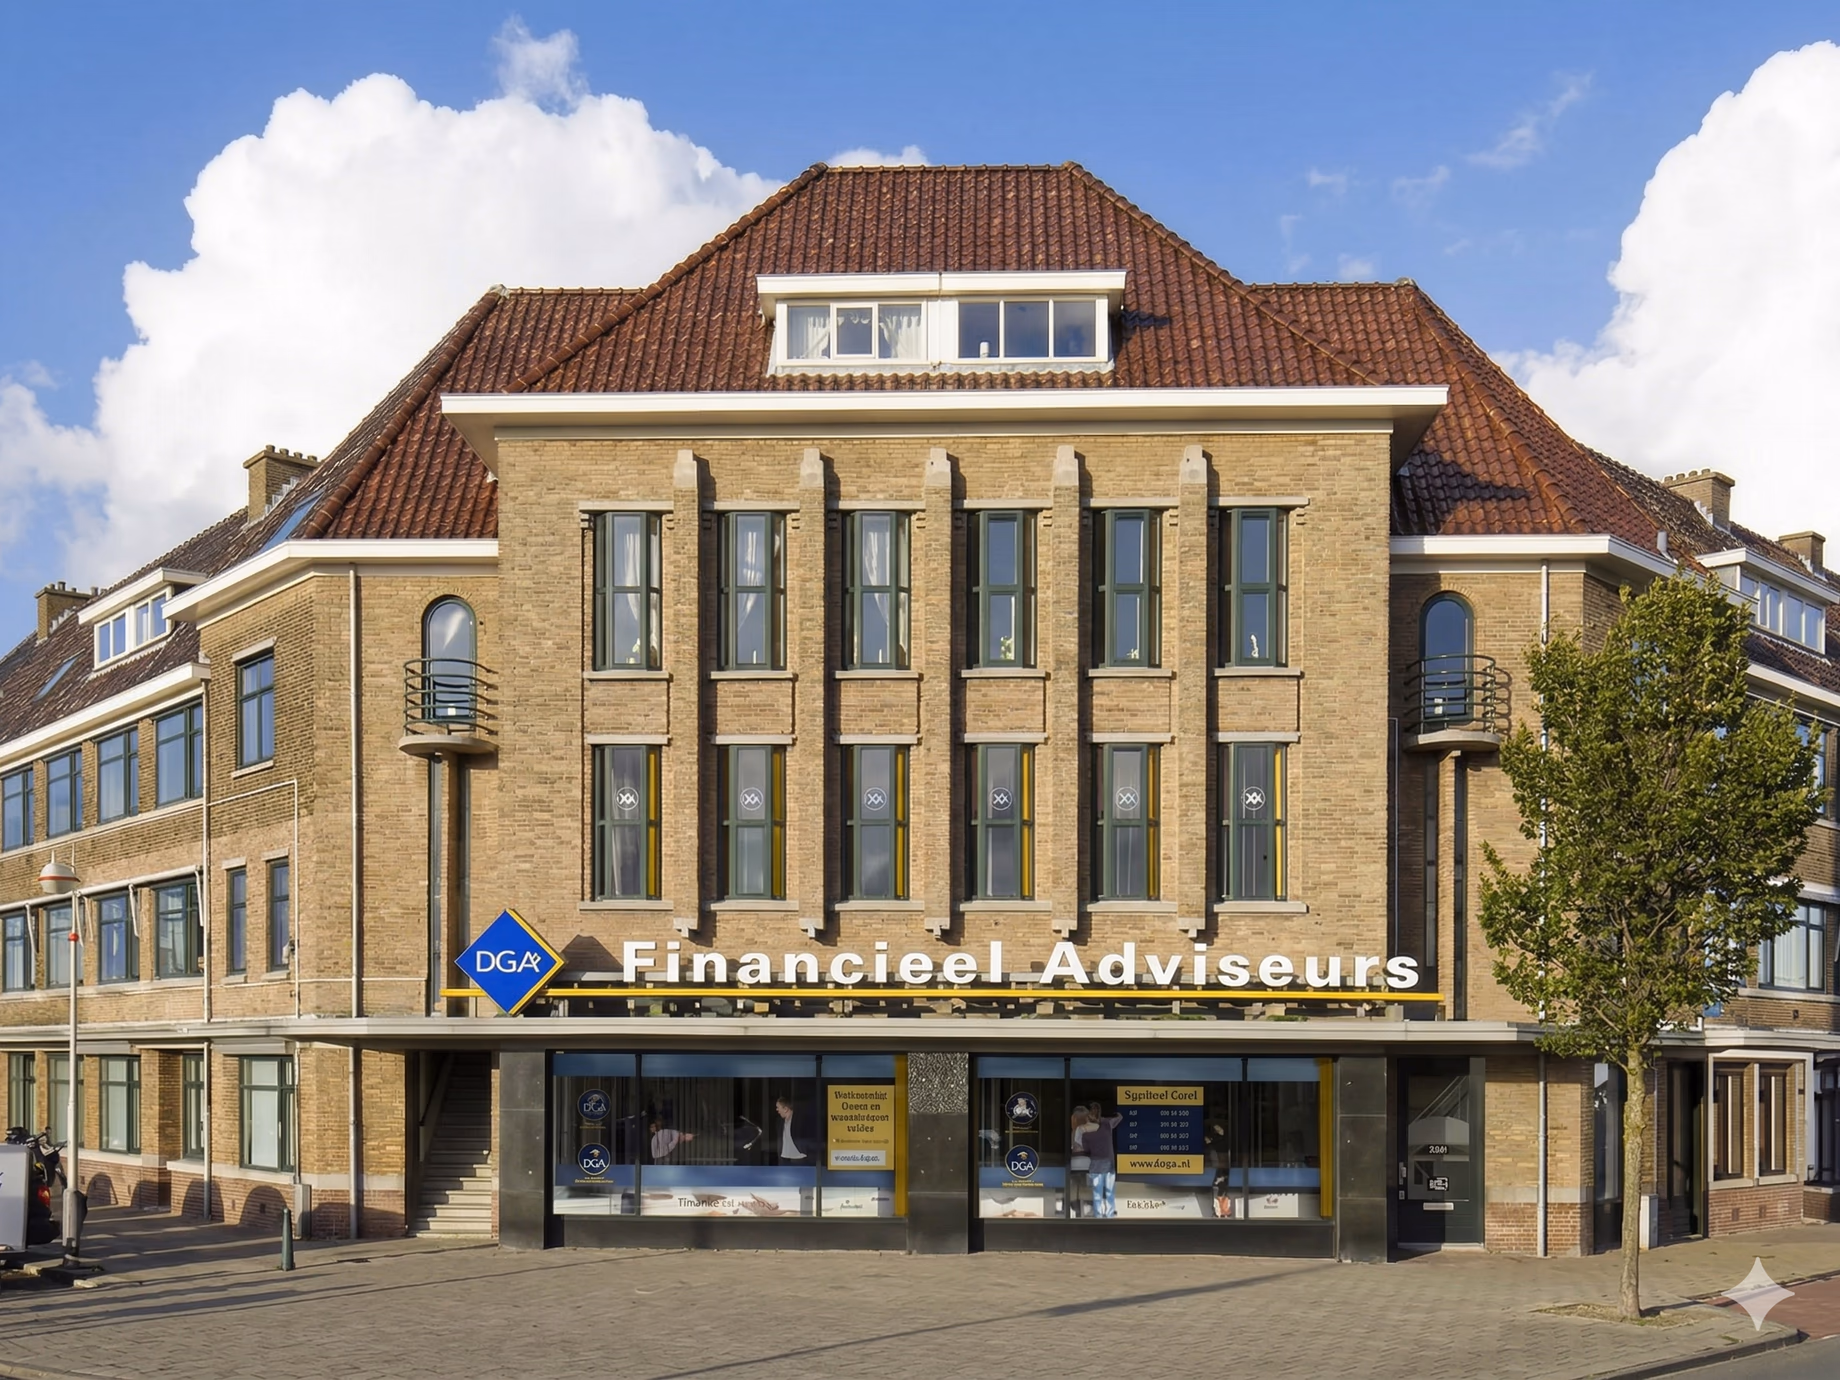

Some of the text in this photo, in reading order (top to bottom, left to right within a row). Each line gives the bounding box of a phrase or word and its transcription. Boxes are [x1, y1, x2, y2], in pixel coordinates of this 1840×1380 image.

[623, 941, 1420, 989] Financieel Adviseurs
[583, 1158, 607, 1168] DGA
[1011, 1161, 1035, 1171] DGA
